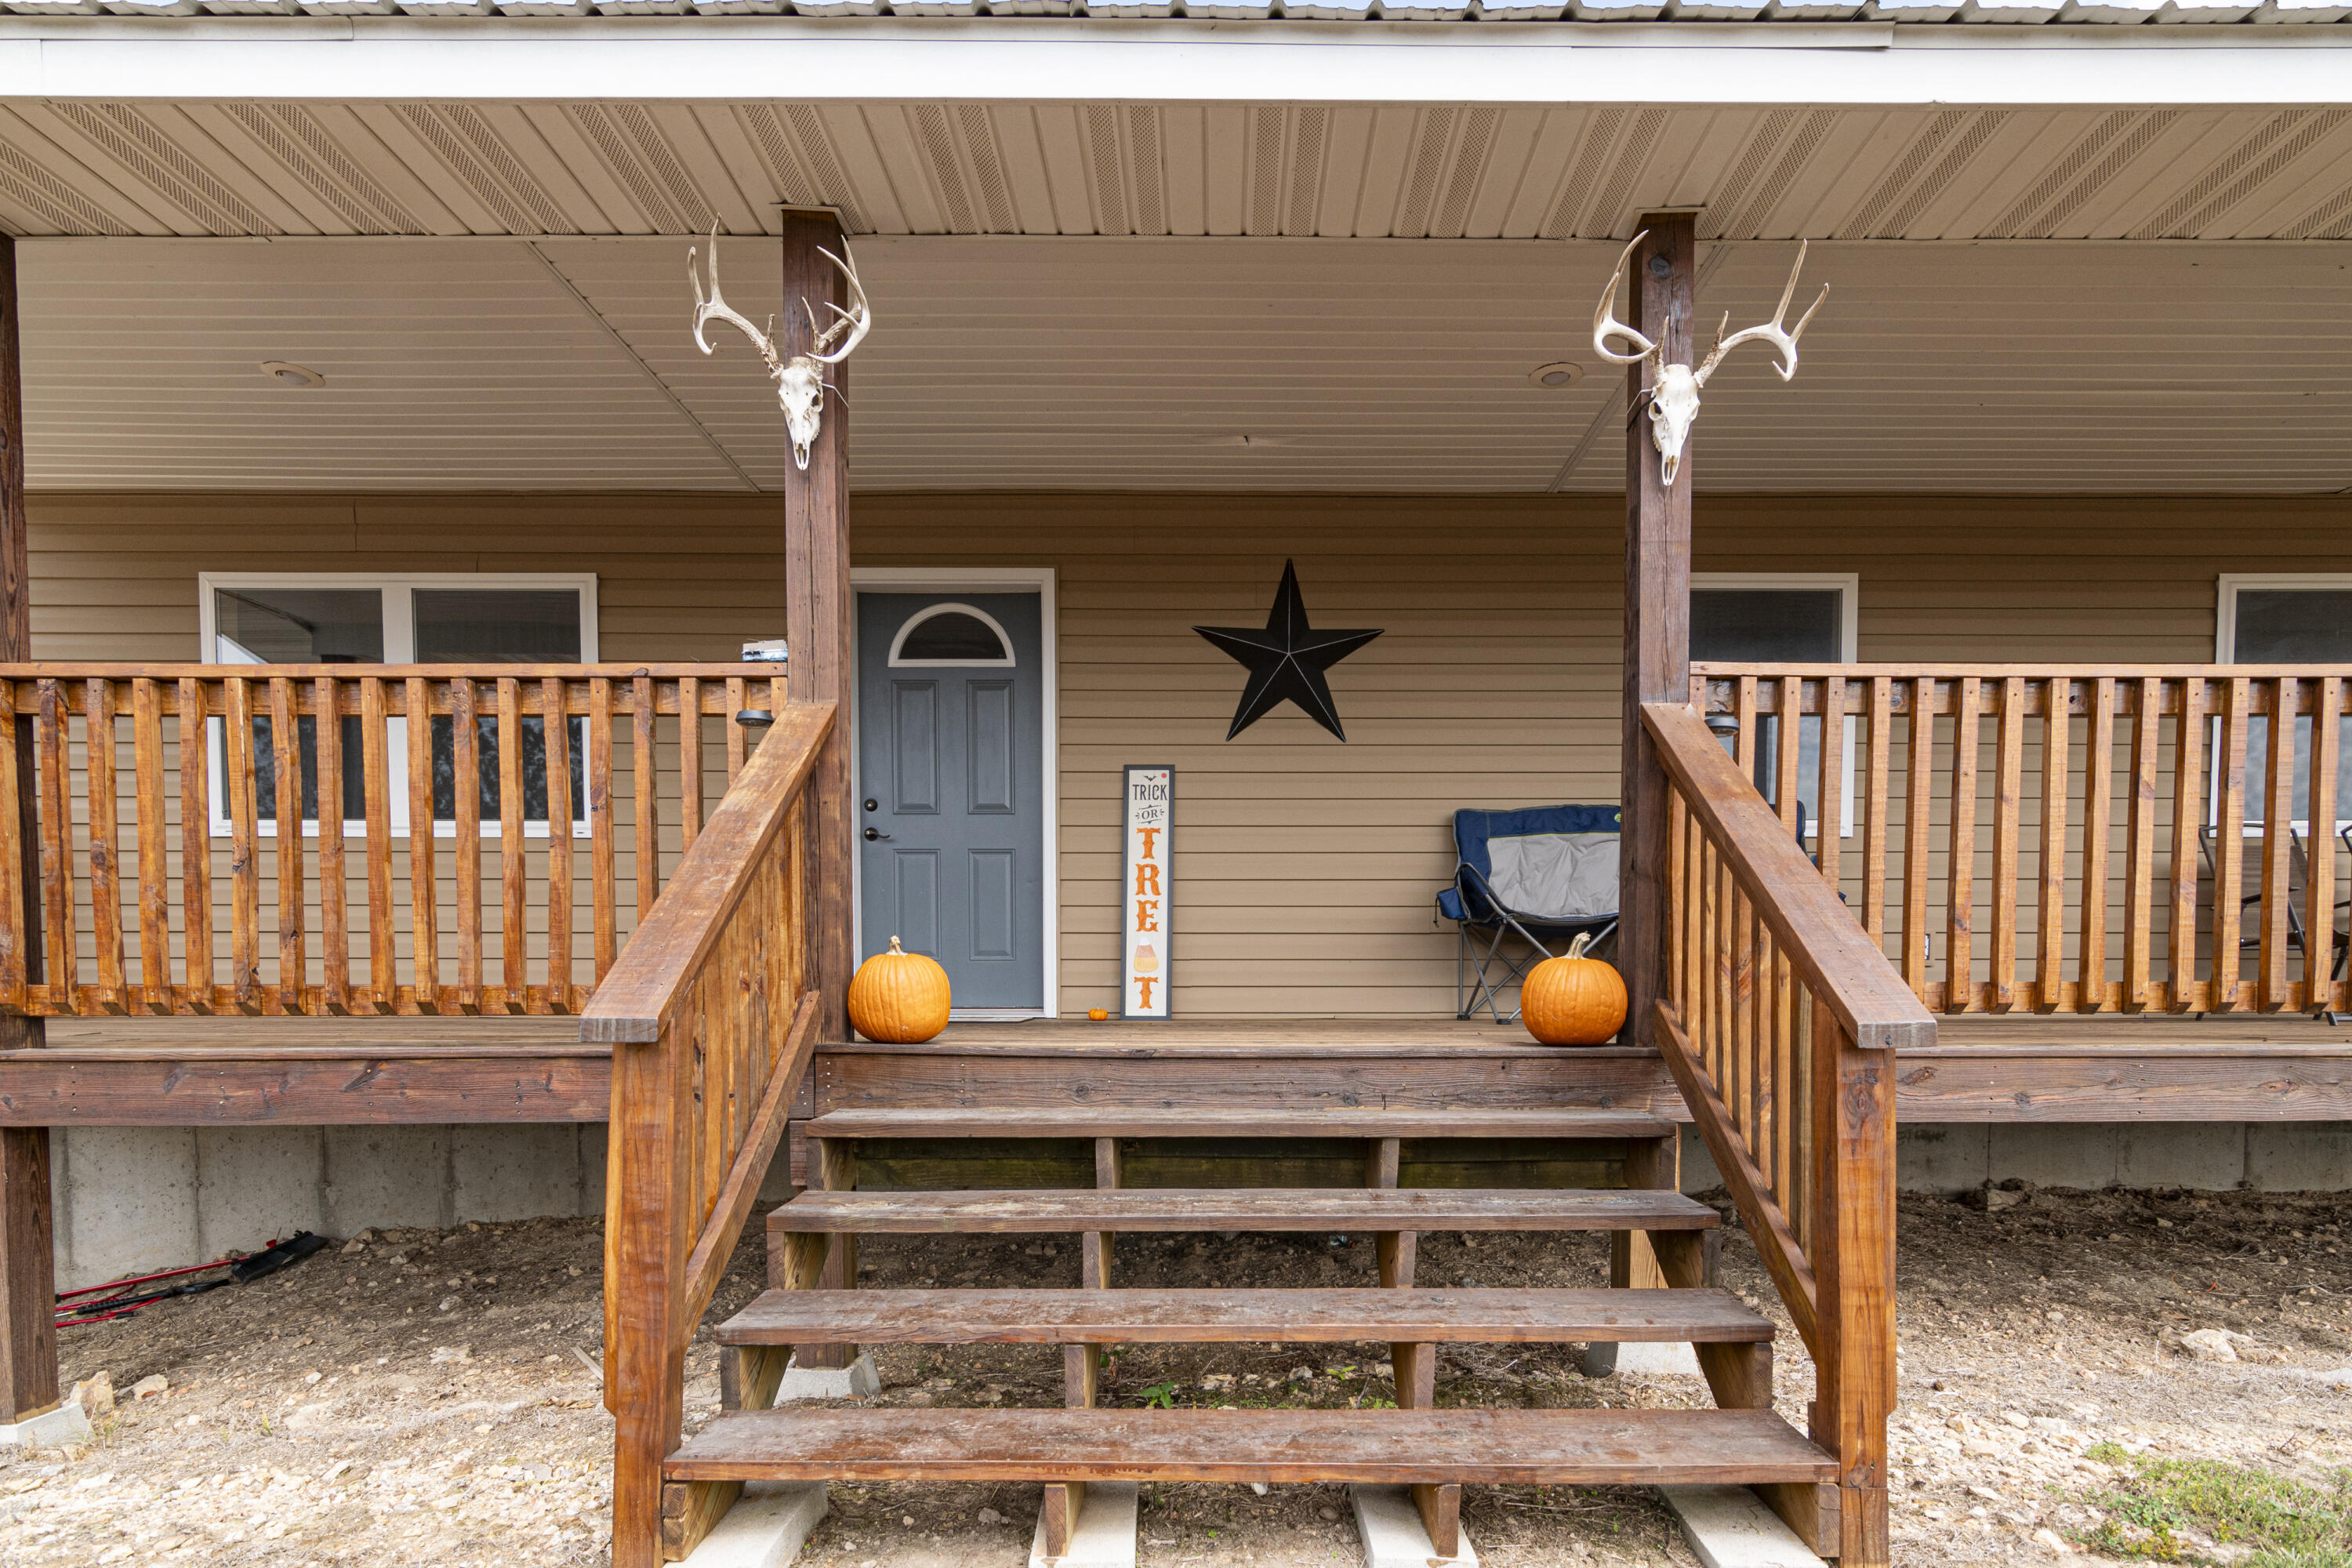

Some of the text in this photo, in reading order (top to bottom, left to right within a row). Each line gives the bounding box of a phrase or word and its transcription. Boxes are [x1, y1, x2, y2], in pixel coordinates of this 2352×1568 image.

[1132, 784, 1167, 800] TRICK
[1142, 808, 1159, 820] OR
[1134, 827, 1162, 1009] TRET
